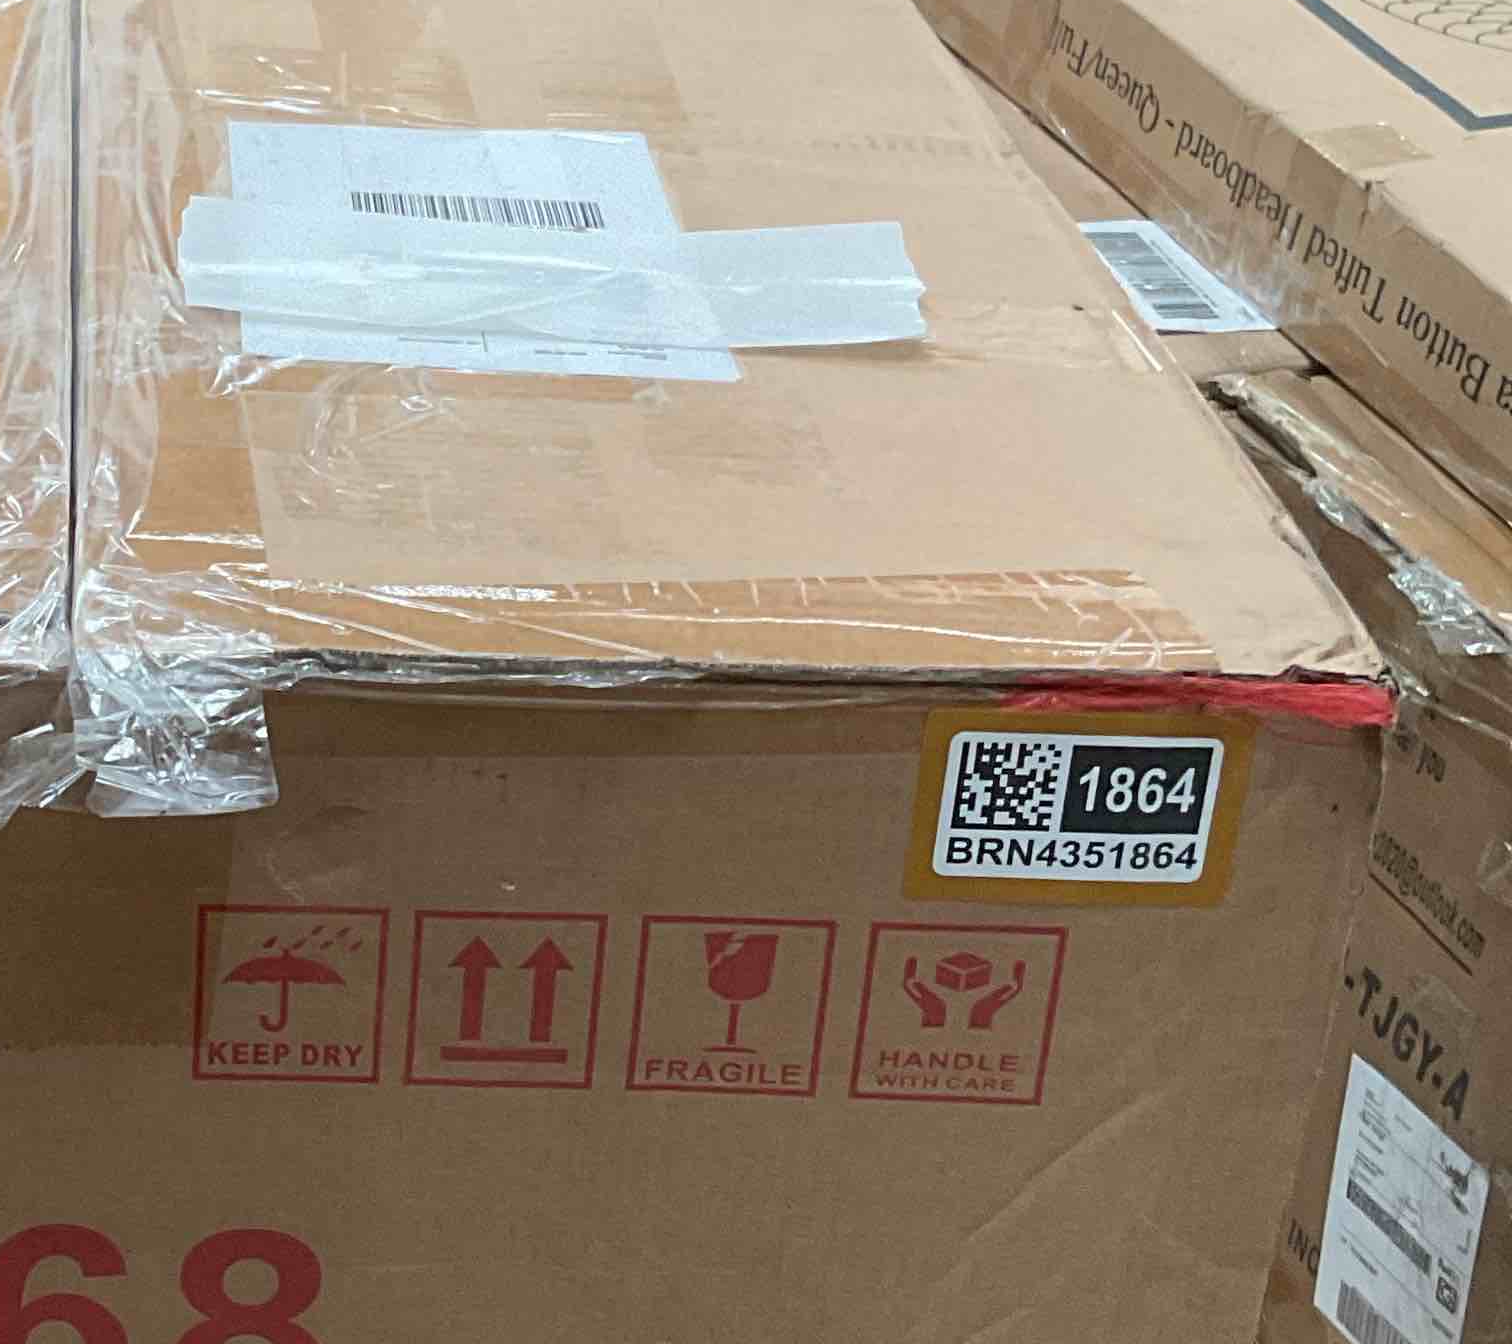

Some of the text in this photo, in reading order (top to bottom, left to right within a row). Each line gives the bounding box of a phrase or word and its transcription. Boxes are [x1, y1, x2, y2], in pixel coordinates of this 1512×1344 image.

[1048, 13, 1161, 135] Queen/Full
[1173, 118, 1303, 251] Headboard
[1302, 223, 1388, 322] Tufted
[1396, 296, 1492, 404] Button
[1079, 765, 1196, 814] 1864
[945, 836, 1198, 870] BRN4351864
[207, 1040, 363, 1067] KEEP DRY
[643, 1057, 804, 1087] FRAGILE
[879, 1050, 1019, 1073] HANDLE
[876, 1074, 1016, 1092] WITH CARE
